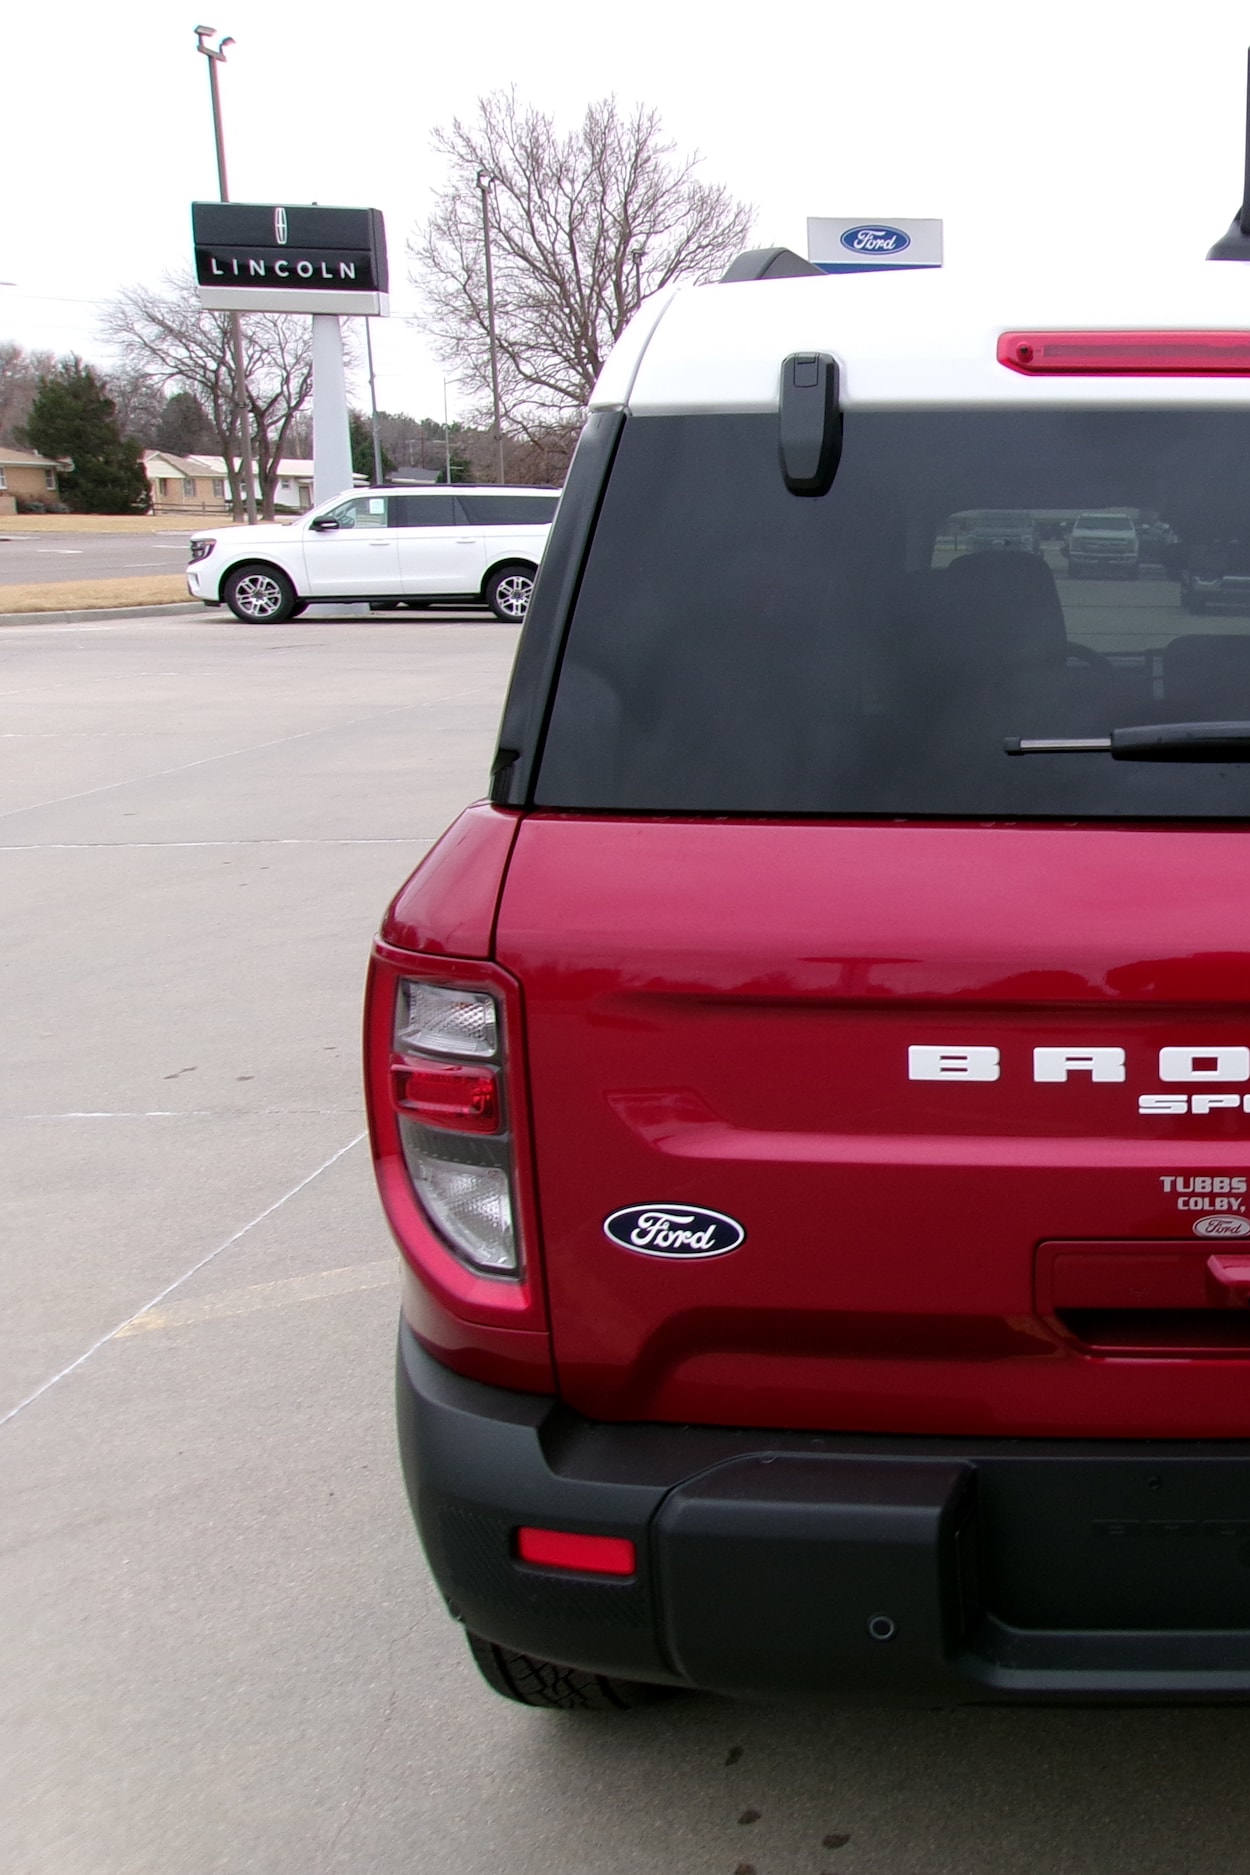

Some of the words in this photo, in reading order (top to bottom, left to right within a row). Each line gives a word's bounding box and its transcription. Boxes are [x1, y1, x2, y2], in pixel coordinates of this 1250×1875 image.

[853, 229, 897, 250] Ford
[211, 257, 356, 280] LINCOLN
[1160, 1176, 1248, 1193] TUBBS
[1177, 1196, 1246, 1213] COLBY,
[630, 1211, 717, 1249] Ford
[1205, 1219, 1242, 1235] Ford
